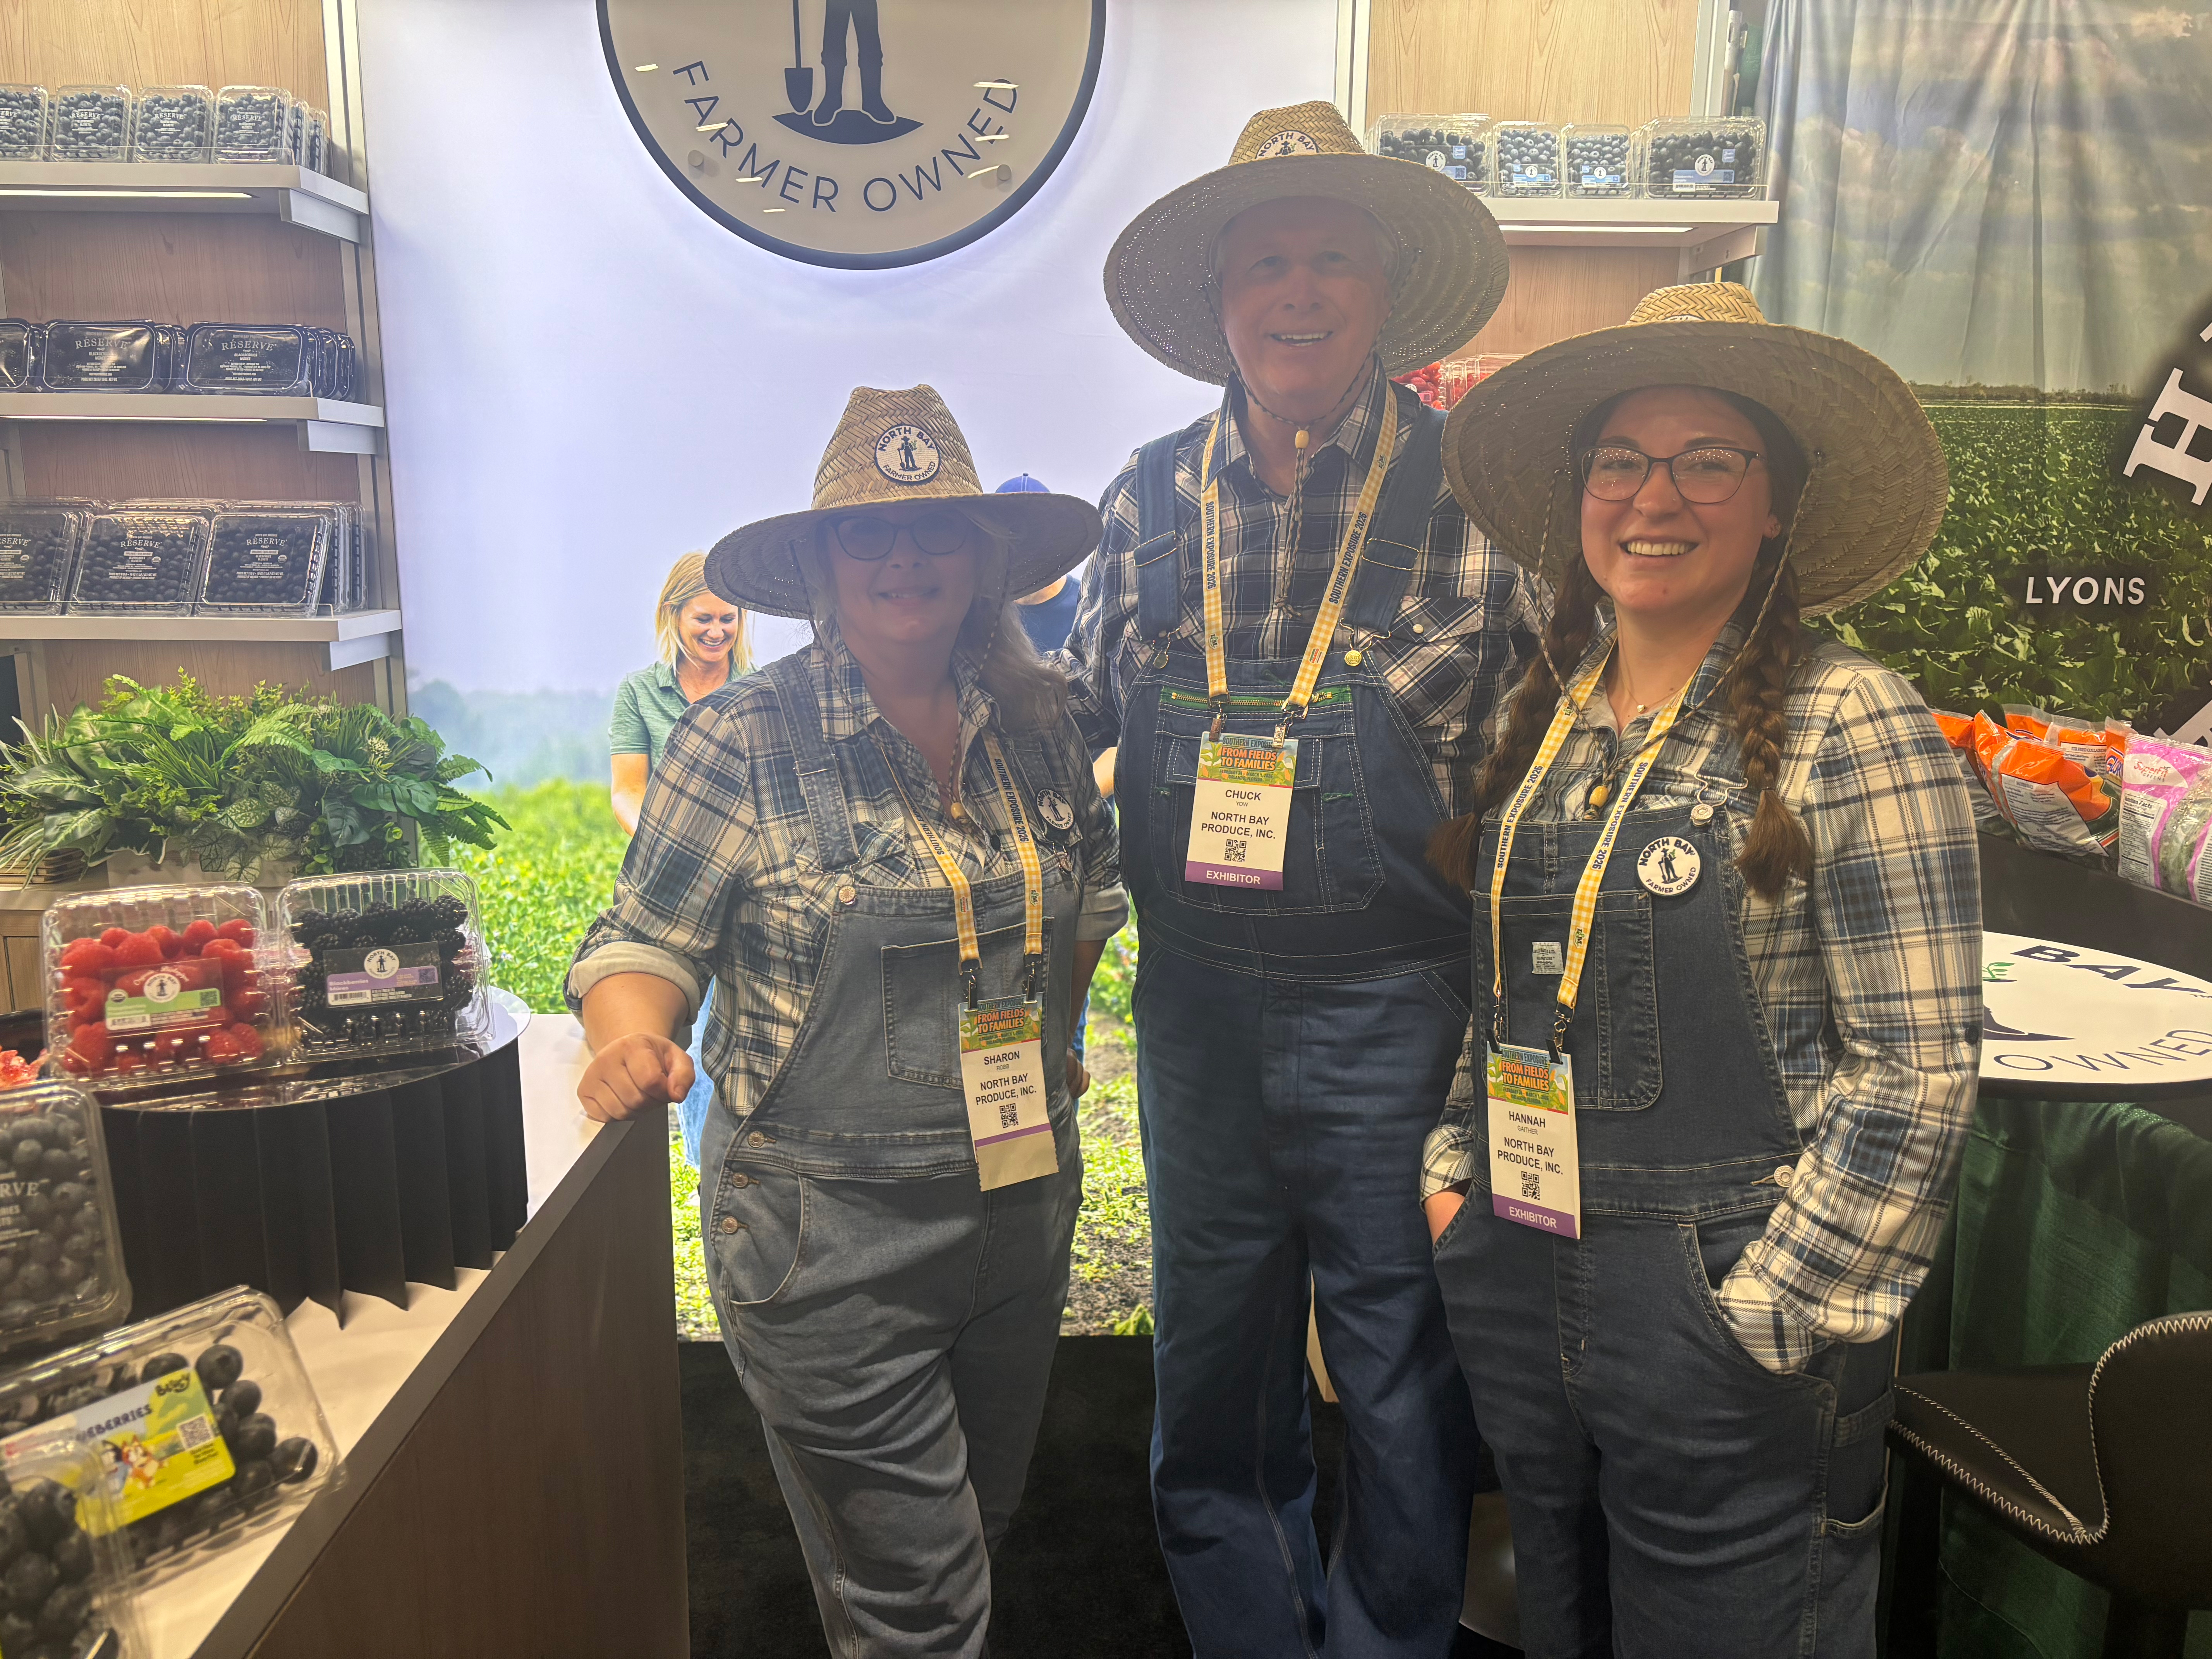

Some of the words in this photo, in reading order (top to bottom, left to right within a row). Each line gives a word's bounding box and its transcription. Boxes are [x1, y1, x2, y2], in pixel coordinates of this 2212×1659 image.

[673, 60, 838, 212] FARMER
[863, 79, 1018, 212] OWNED
[1259, 132, 1294, 156] NORTH
[1297, 136, 1314, 150] BAY
[75, 337, 128, 349] RÉSERVE
[222, 338, 273, 351] RÉSERVE
[878, 427, 911, 452] NORTH
[916, 431, 935, 449] BAY
[883, 464, 912, 481] FARMER
[914, 461, 936, 480] OWNED
[1206, 501, 1214, 535] SOUTHERN
[246, 536, 285, 546] RÉSERVE
[1206, 538, 1216, 572] EXPOSURE
[1329, 565, 1349, 605] SOUTHERN
[1341, 529, 1361, 568] EXPOSURE
[1355, 511, 1367, 532] 2026
[1207, 571, 1216, 589] 2026
[2026, 576, 2145, 605] LYONS
[1223, 737, 1249, 747] SOUTHERN
[1250, 740, 1275, 749] EXPOSU
[1221, 756, 1234, 767] TO
[1234, 758, 1276, 771] FAMILIES
[1222, 747, 1247, 758] FROM
[1249, 749, 1277, 761] FIELDS
[1620, 761, 1648, 803] SOUTHERN
[2142, 773, 2165, 782] GREENS
[994, 758, 1013, 791] SOUTHERN
[1006, 791, 1024, 825] EXPOSURE
[1016, 826, 1029, 842] 2026
[1225, 790, 1262, 801] CHUCK
[2139, 800, 2153, 809] Facts
[1211, 811, 1246, 823] NORTH
[1249, 815, 1269, 826] BAY
[1497, 825, 1513, 869] SOUTHERN
[1509, 785, 1531, 824] EXPOSURE
[1527, 765, 1543, 788] 2026
[1600, 804, 1626, 848] EXPOSURE
[920, 823, 945, 855] SOUTHERN
[1201, 823, 1253, 838] PRODUCE,
[1256, 829, 1276, 839] INC.
[1591, 849, 1608, 871] 2026
[1638, 838, 1670, 866] NORTH
[1674, 839, 1694, 855] BAY
[1206, 870, 1261, 885] EXHIBITOR
[1646, 878, 1674, 893] FARMER
[1676, 867, 1696, 891] OWNED
[367, 951, 385, 963] NORTH
[386, 951, 396, 962] BAY
[2010, 945, 2209, 993] BAY
[977, 1011, 1000, 1024] FROM
[1000, 1008, 1025, 1020] FIELDS
[978, 1023, 988, 1034] TO
[989, 1017, 1024, 1032] FAMILIES
[984, 1051, 1020, 1065] SHARON
[1524, 1053, 1547, 1065] EXPOSURE
[1994, 1030, 2212, 1071] OWNED
[1502, 1061, 1523, 1075] FROM
[1524, 1065, 1548, 1079] FIELDS
[980, 1076, 1010, 1091] NORTH
[1012, 1073, 1029, 1084] BAY
[1502, 1072, 1513, 1084] TO
[1513, 1074, 1549, 1092] FAMILIES
[975, 1089, 1019, 1106] PRODUCE,
[1020, 1085, 1037, 1096] INC.
[1509, 1111, 1546, 1128] HANNAH
[1517, 1125, 1538, 1135] GAITHER
[1504, 1137, 1534, 1153] NORTH
[1537, 1144, 1554, 1158] BAY
[1497, 1149, 1543, 1171] PRODUCE,
[1545, 1161, 1563, 1175] INC.
[1509, 1206, 1557, 1228] EXHIBITOR
